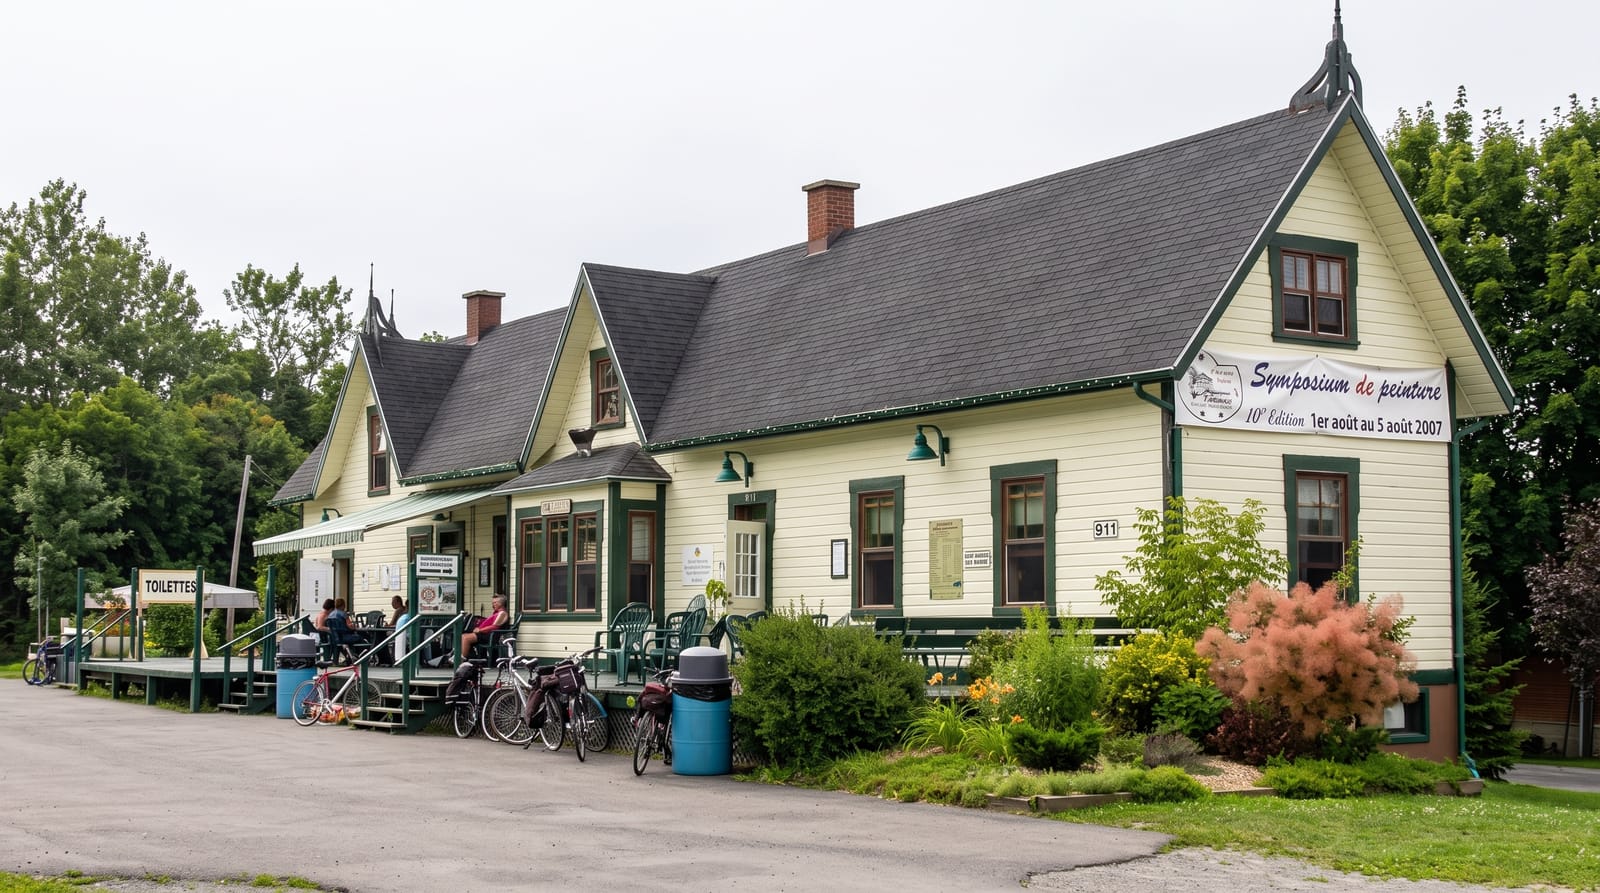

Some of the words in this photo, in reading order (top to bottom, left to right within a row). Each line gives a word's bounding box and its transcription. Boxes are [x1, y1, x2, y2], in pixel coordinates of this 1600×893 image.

[1250, 362, 1350, 397] Symposium
[1355, 374, 1374, 396] de
[1378, 379, 1442, 403] peinture
[1311, 413, 1330, 429] 1er
[1331, 414, 1359, 431] août
[1361, 418, 1375, 432] au
[1377, 417, 1384, 433] 5
[1386, 417, 1413, 434] août
[1415, 420, 1442, 436] 2007
[1095, 522, 1116, 536] 911
[145, 580, 197, 593] TOILETTES
